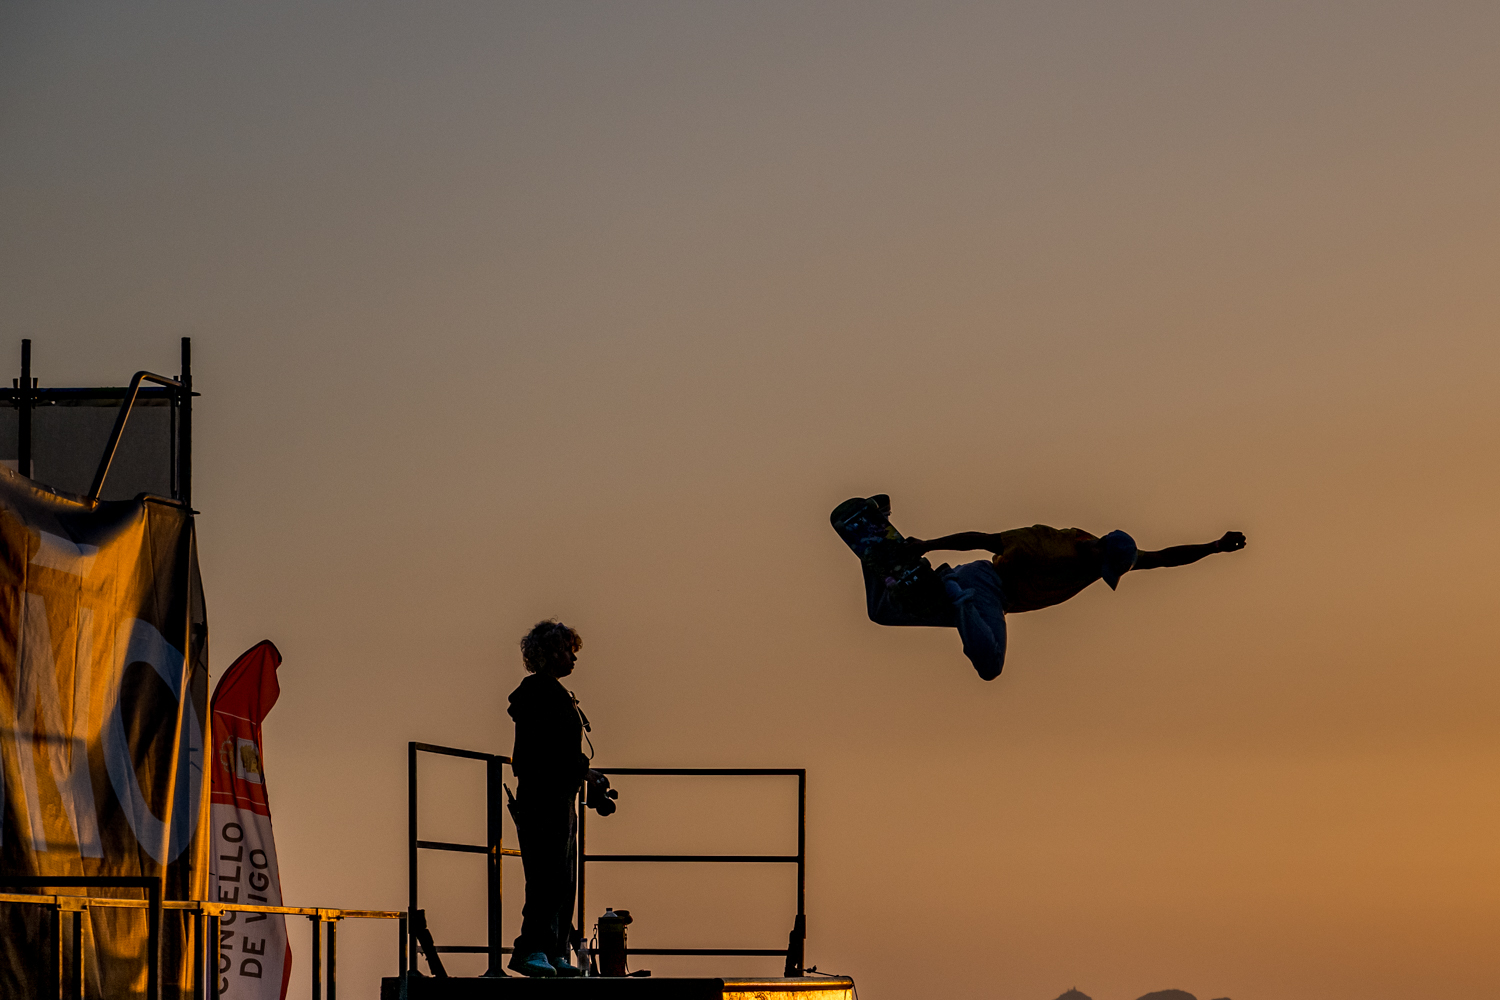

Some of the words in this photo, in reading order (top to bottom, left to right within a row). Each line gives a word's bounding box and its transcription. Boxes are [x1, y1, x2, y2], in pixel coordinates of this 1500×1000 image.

[0, 530, 204, 866] ÑO
[245, 848, 269, 923] VIGO
[240, 937, 265, 978] DE
